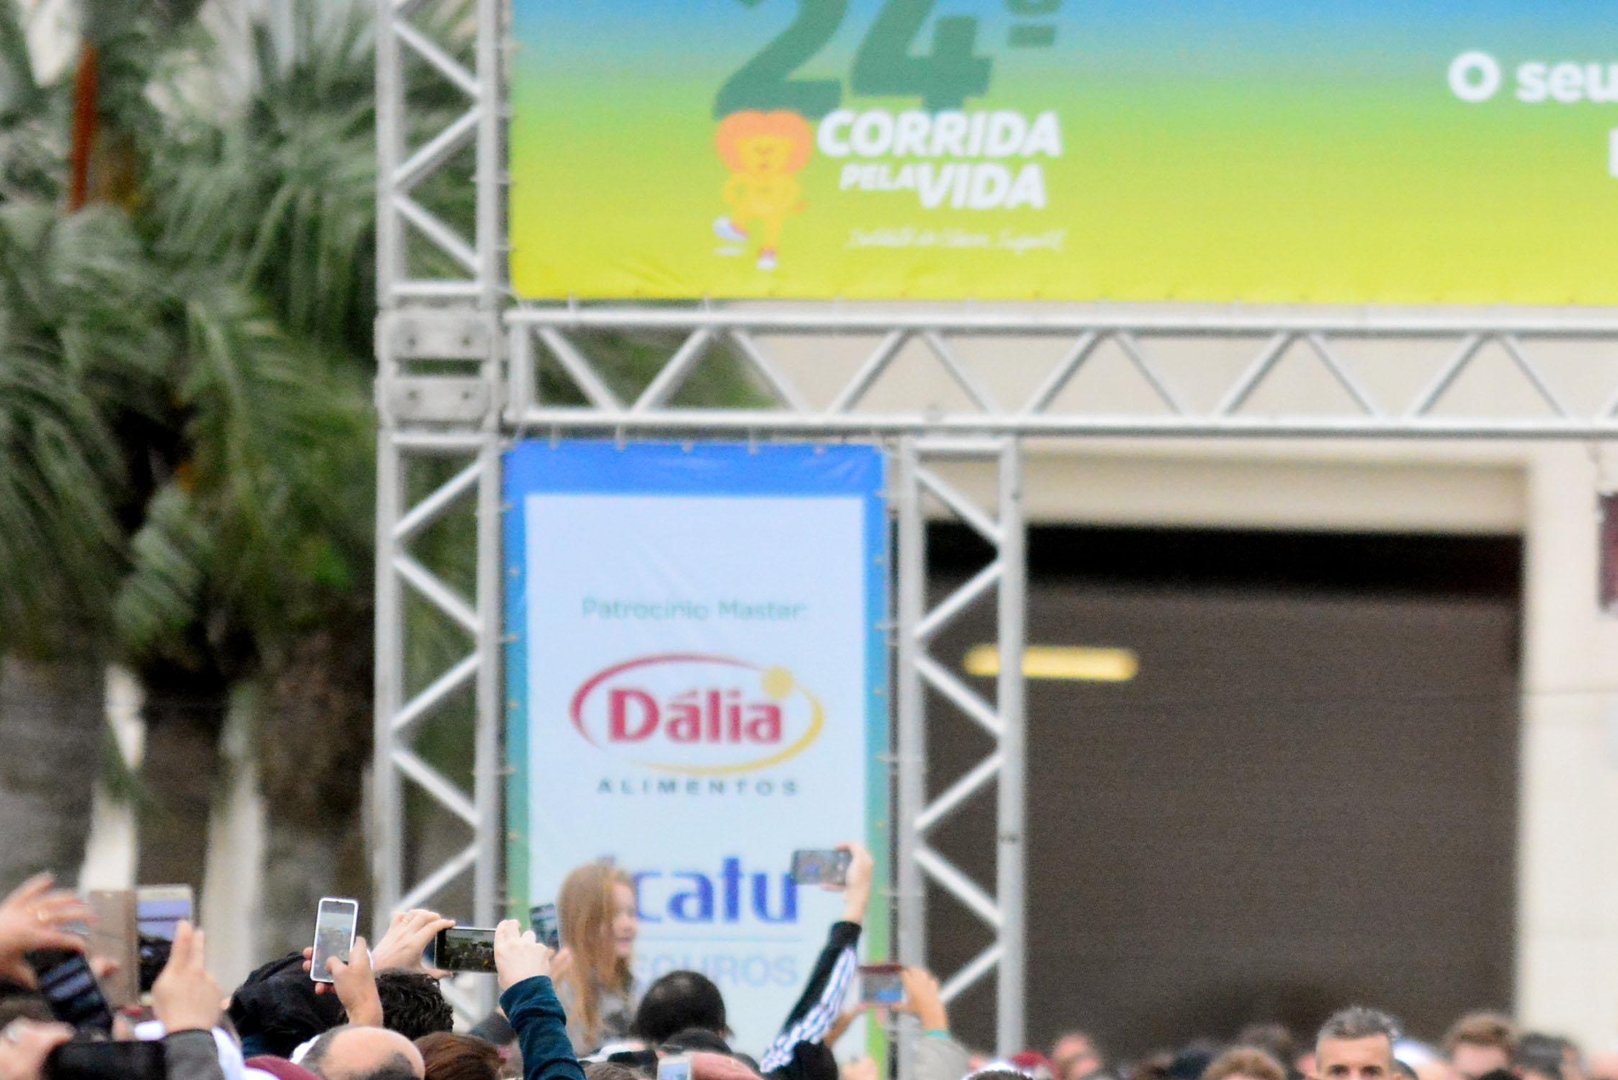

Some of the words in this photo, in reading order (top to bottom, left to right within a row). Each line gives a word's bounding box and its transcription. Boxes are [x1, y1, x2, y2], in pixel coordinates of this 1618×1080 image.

[1447, 50, 1499, 103] O
[816, 109, 1063, 158] CORRIDA
[838, 163, 916, 191] PELA
[914, 163, 1048, 210] VIDA
[608, 687, 782, 744] Dália
[596, 776, 799, 797] ALIMENTOS
[630, 856, 798, 924] catu
